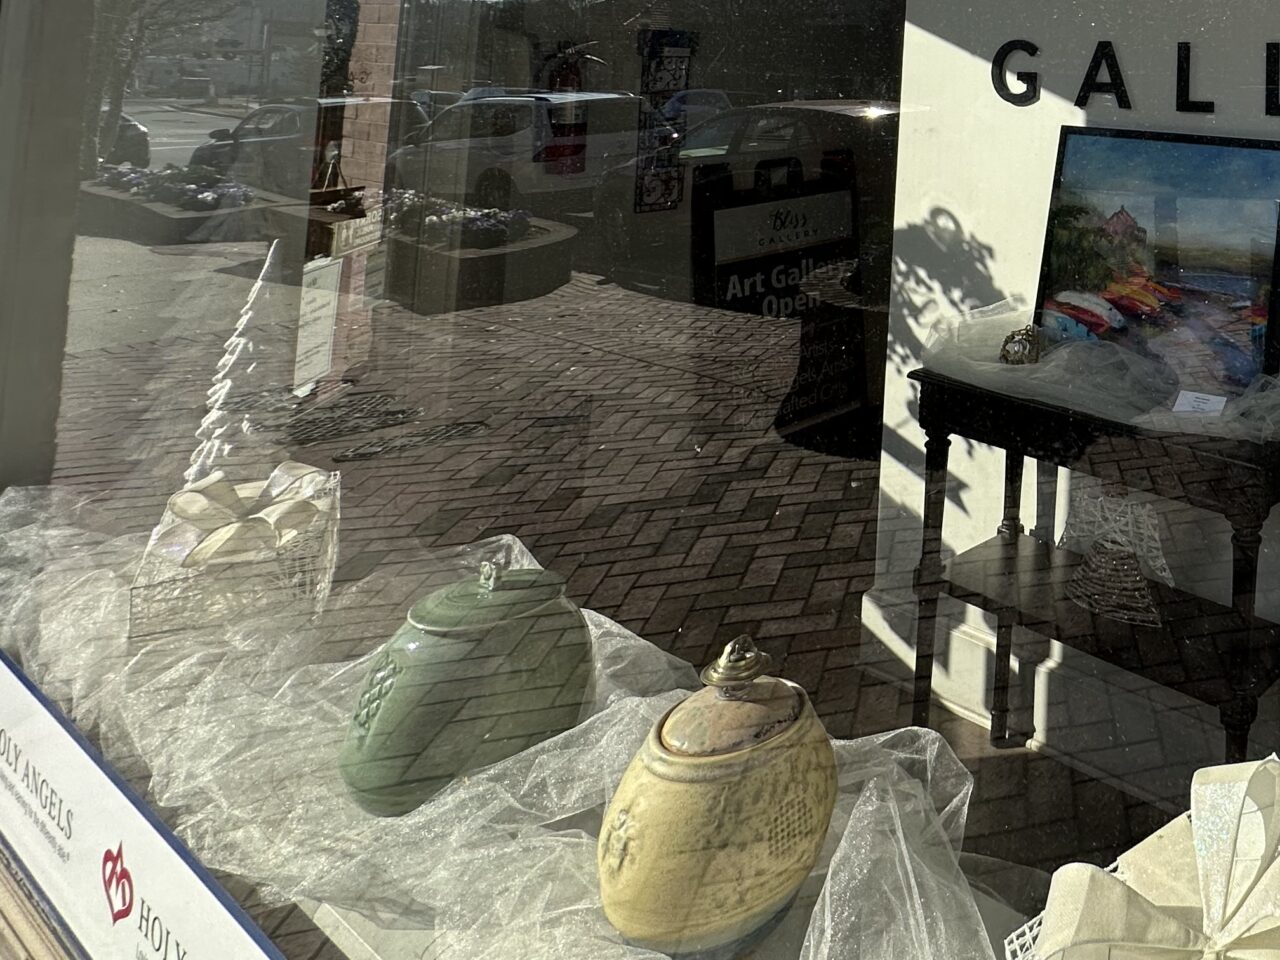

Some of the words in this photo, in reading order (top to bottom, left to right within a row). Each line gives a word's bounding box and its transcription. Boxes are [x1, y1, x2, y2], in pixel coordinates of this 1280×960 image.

[769, 208, 808, 232] Bliss
[758, 229, 818, 246] GALLERY
[726, 271, 765, 301] Art
[762, 290, 821, 318] Open
[21, 758, 74, 841] ANGELS
